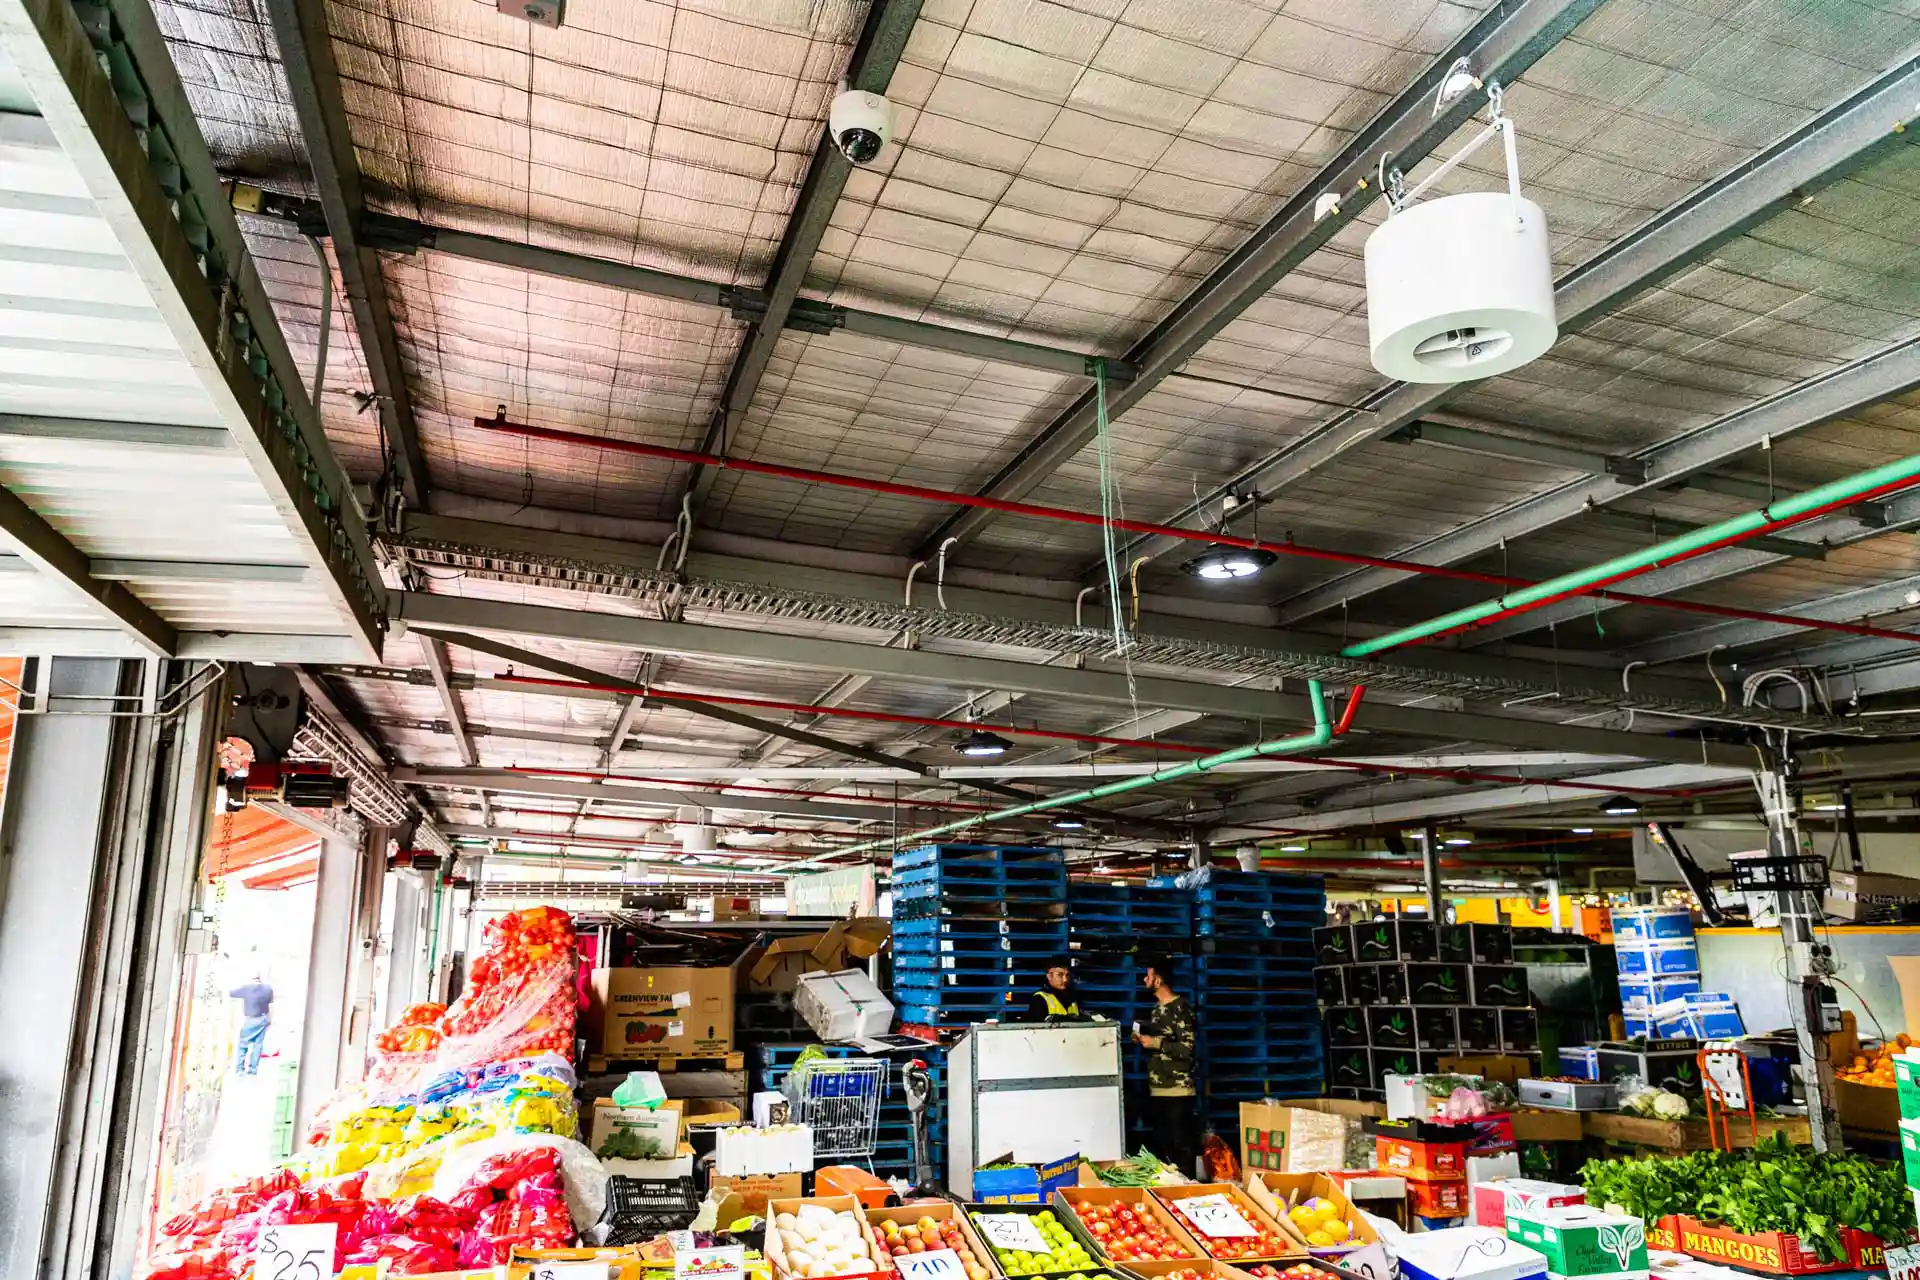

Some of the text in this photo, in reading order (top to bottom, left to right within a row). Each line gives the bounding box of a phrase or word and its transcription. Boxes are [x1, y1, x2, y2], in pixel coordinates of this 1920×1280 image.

[614, 994, 659, 1003] GREENVIEW
[260, 1229, 279, 1255] $
[1684, 1231, 1780, 1268] MANGOES
[272, 1250, 325, 1280] 25
